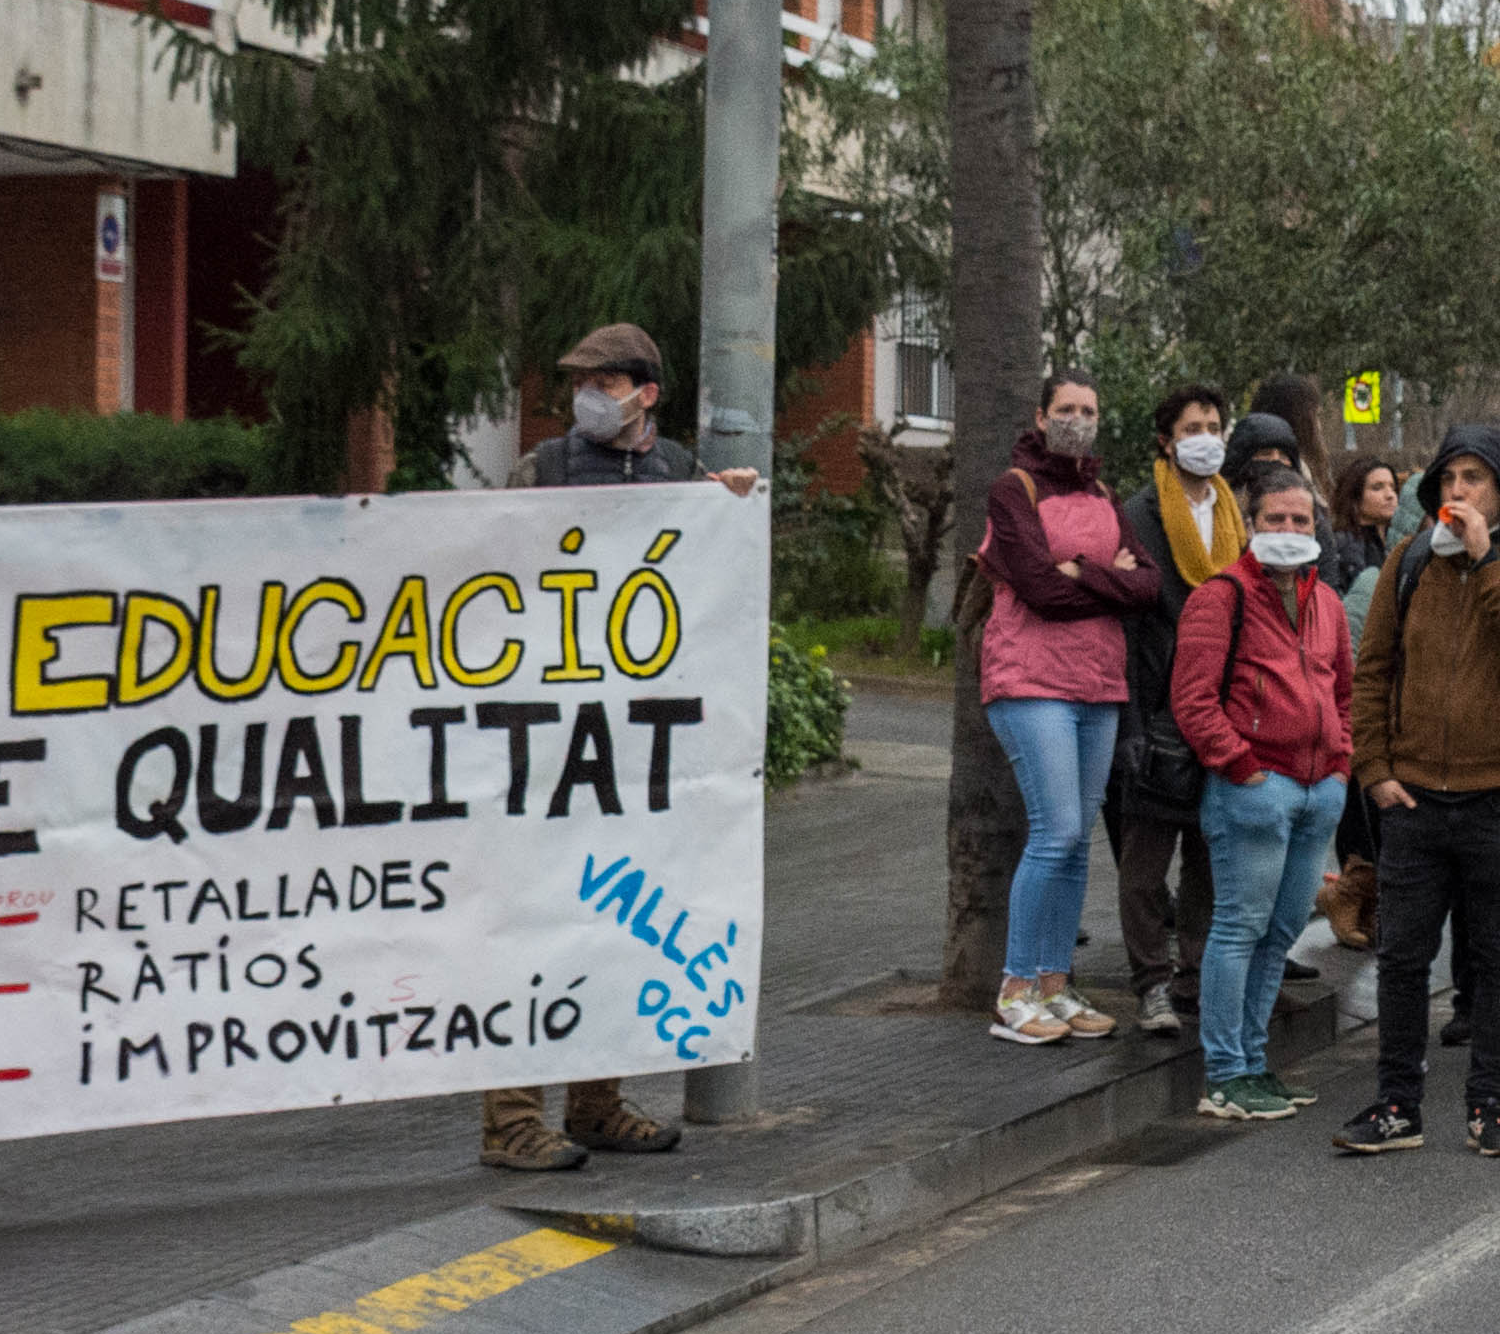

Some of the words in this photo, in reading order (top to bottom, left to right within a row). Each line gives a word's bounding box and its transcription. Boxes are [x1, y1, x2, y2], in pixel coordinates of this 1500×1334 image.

[10, 526, 682, 717] EDUCACIÓ
[115, 696, 704, 845] QUALITAT
[74, 860, 451, 933] RETALLADES
